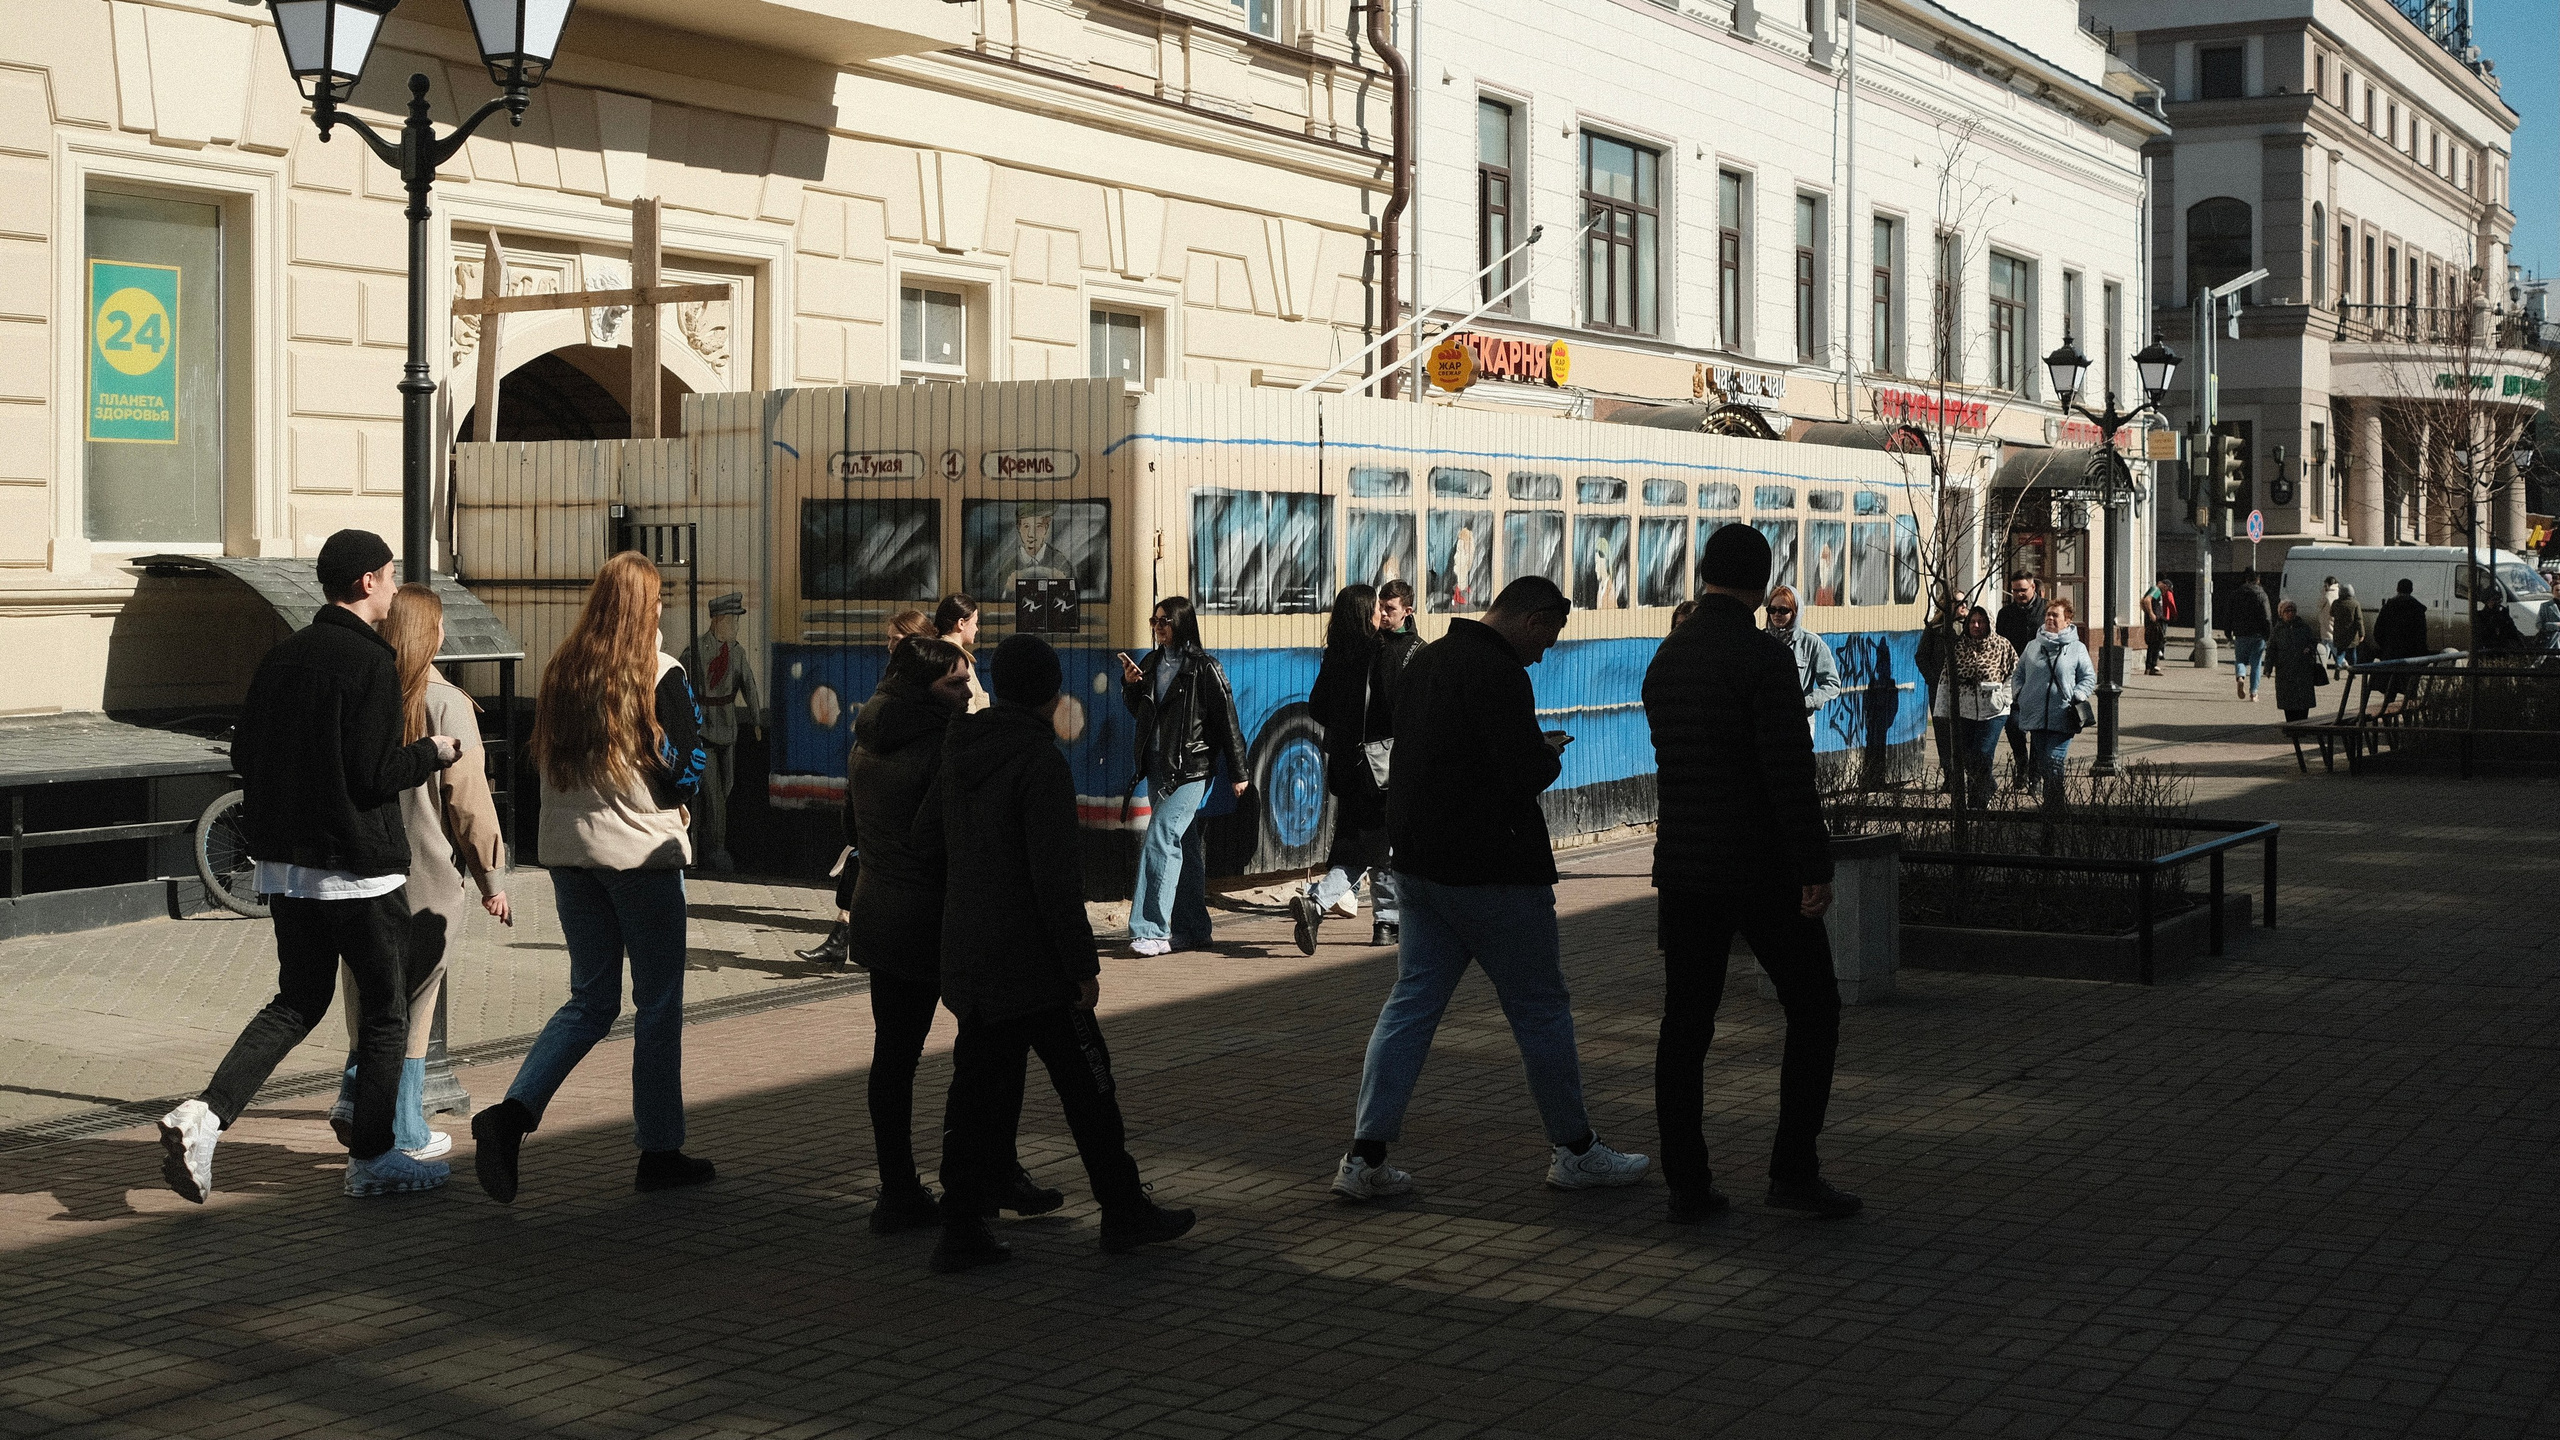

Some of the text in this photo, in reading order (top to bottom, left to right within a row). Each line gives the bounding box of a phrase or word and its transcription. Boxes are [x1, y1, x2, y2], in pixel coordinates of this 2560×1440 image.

[105, 310, 165, 353] 24
[1438, 361, 1462, 371] ЖАР
[99, 393, 165, 408] ПЛАНЕТА
[94, 407, 170, 422] ЗДОРОВЬЯ
[946, 453, 959, 477] 1
[997, 454, 1055, 478] Кремль
